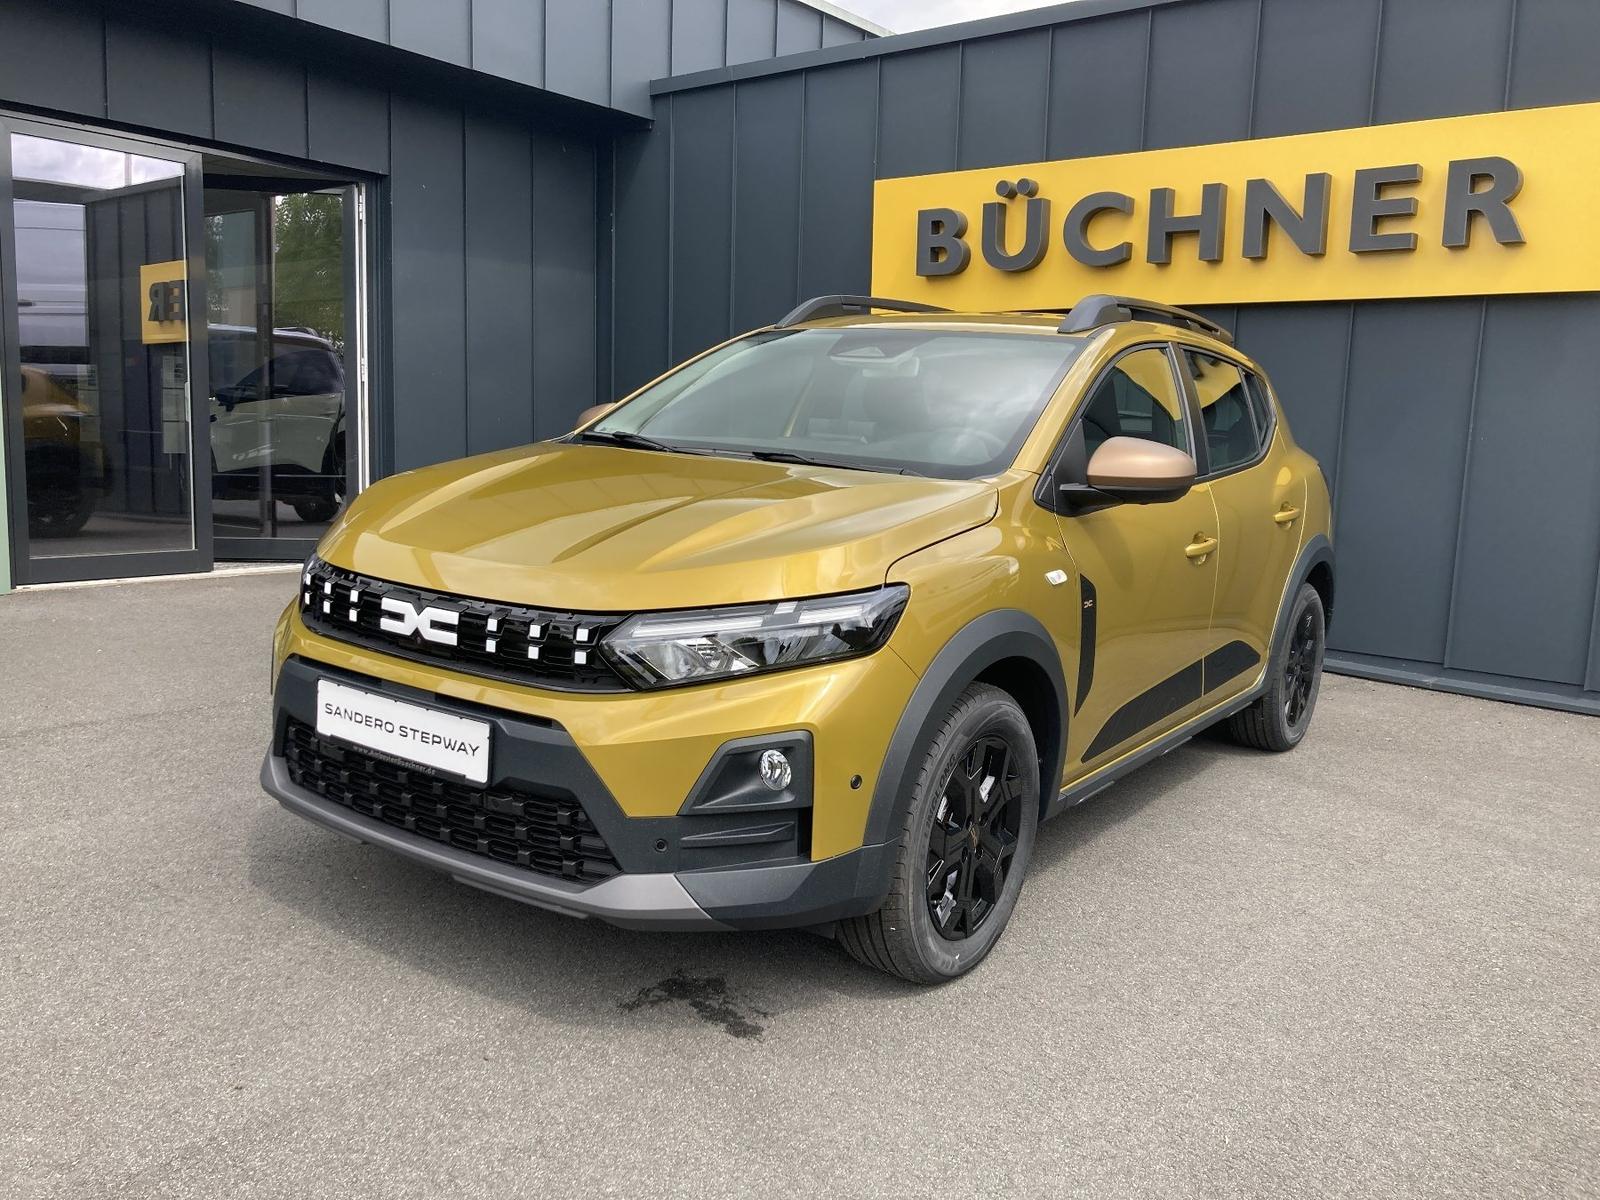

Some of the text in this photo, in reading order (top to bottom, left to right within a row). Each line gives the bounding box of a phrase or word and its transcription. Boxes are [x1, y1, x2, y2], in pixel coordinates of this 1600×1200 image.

[915, 156, 1526, 277] BÜCHNER
[325, 703, 480, 757] SANDERO STEPWAY
